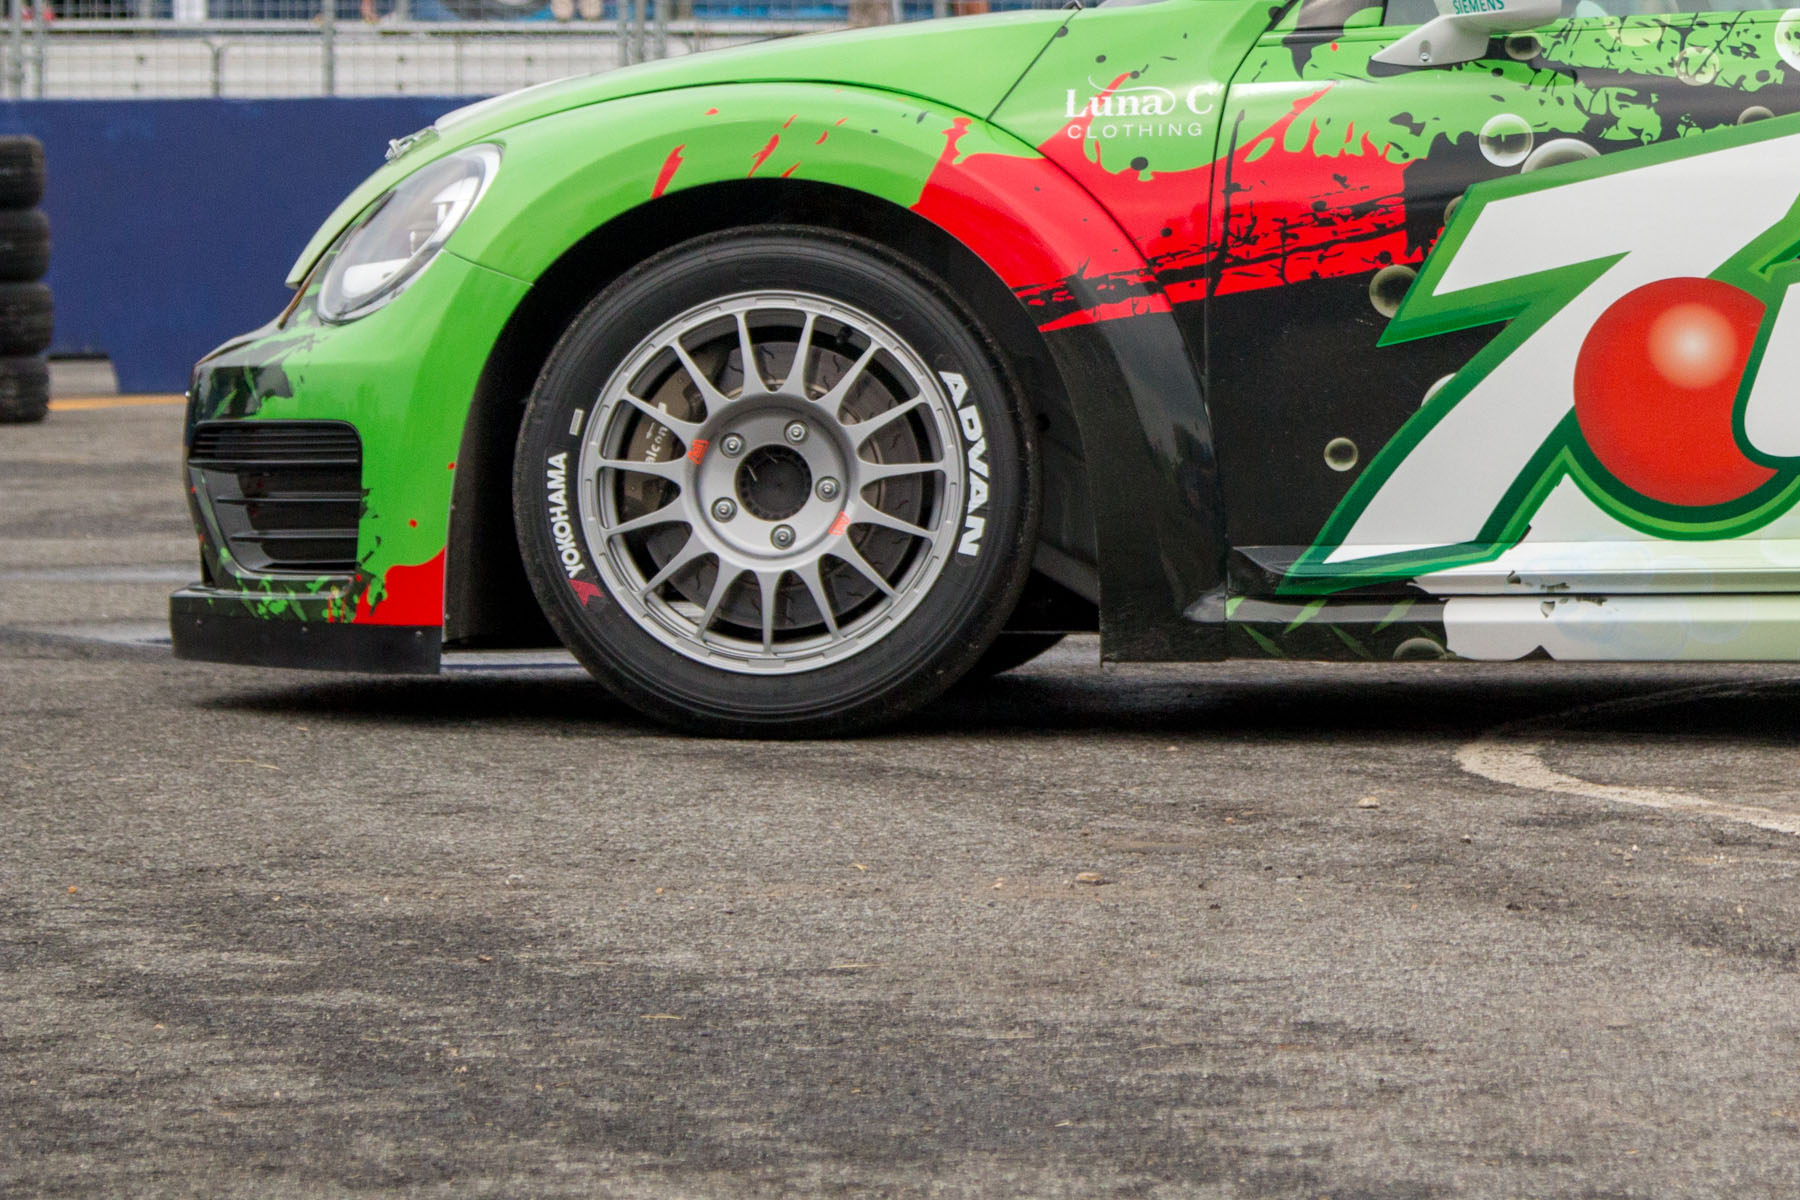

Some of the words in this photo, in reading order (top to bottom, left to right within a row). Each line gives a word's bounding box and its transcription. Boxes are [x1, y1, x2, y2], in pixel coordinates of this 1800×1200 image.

[1064, 76, 1175, 118] Luna
[1066, 121, 1203, 140] CLOTHING
[938, 370, 994, 558] ADVAN
[547, 452, 585, 579] YOKOHAMA
